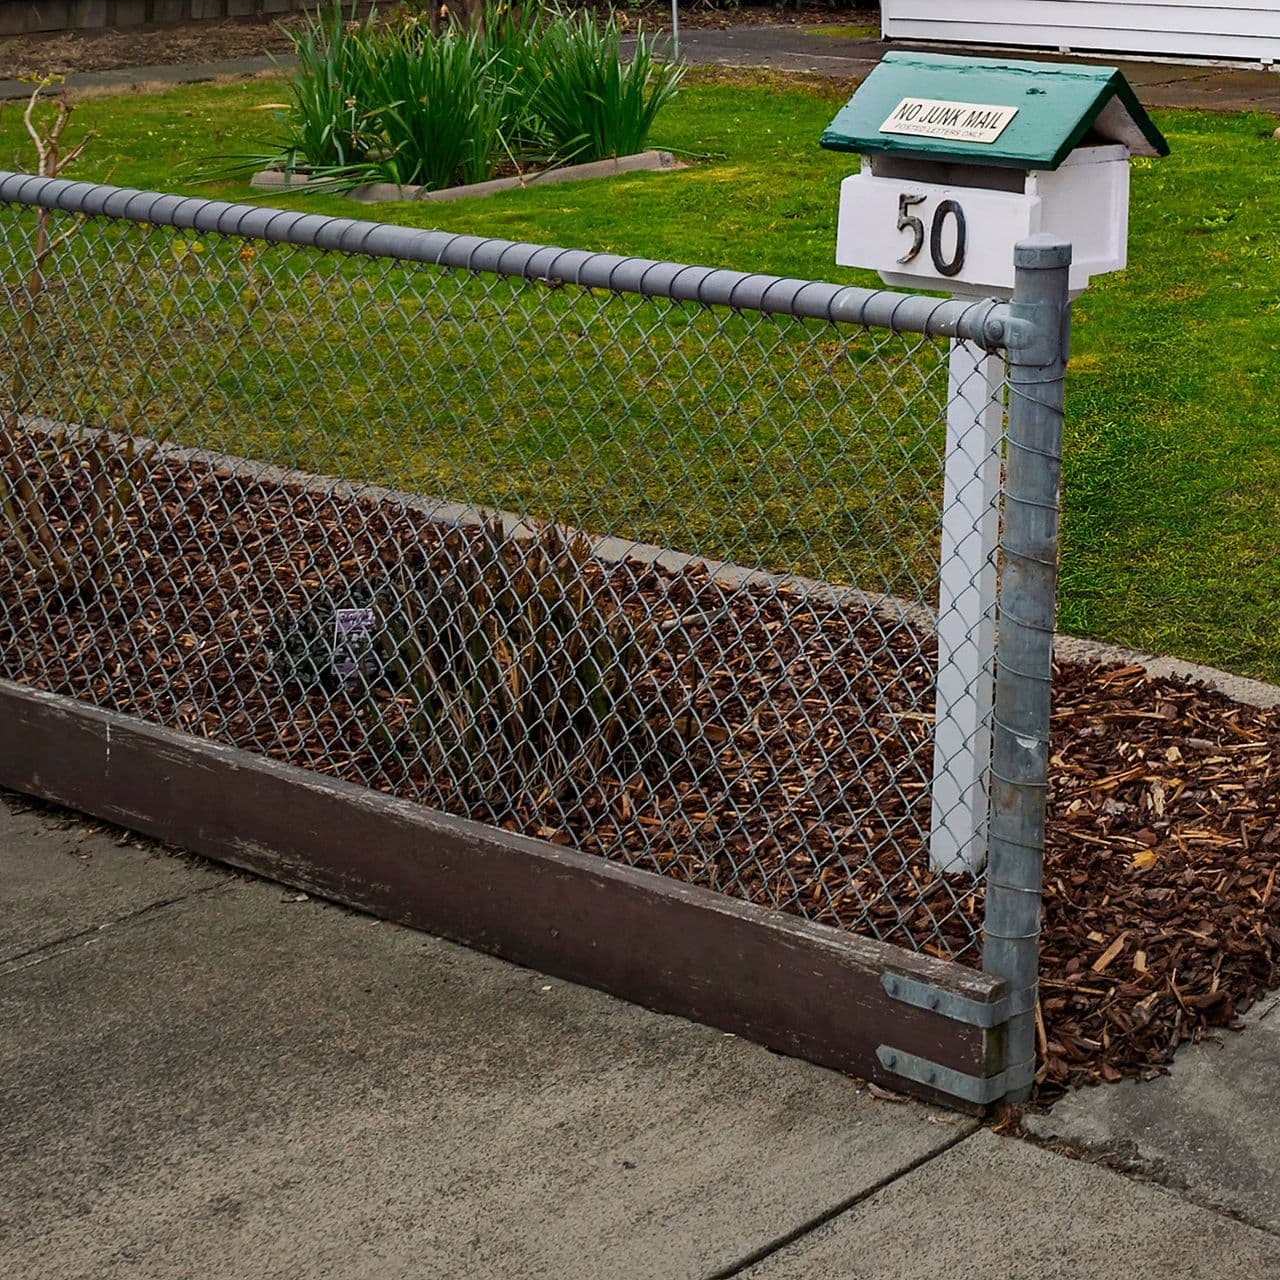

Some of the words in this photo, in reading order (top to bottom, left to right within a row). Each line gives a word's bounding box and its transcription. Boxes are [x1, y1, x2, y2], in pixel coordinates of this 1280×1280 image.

[893, 103, 923, 121] NO
[919, 106, 966, 126] JUNK
[961, 110, 1004, 129] MAIL
[896, 192, 967, 277] 50
